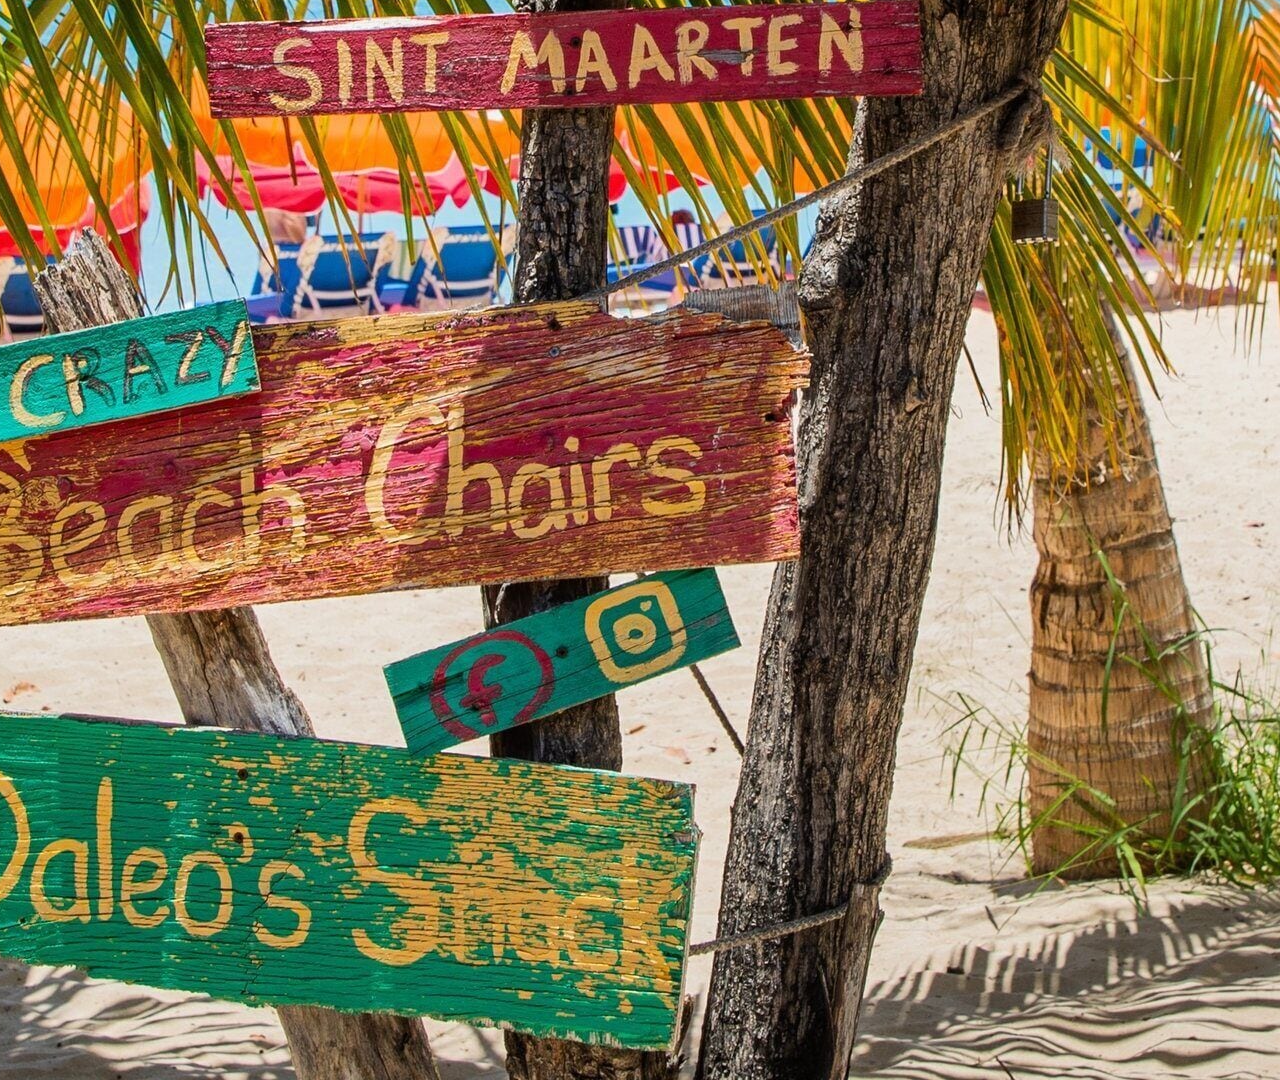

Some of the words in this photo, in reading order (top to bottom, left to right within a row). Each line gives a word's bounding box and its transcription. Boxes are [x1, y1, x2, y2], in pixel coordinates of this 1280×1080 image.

[269, 32, 450, 114] SINT
[500, 3, 864, 96] MAARTEN
[8, 320, 249, 428] CRAZY
[364, 401, 705, 546] Chairs
